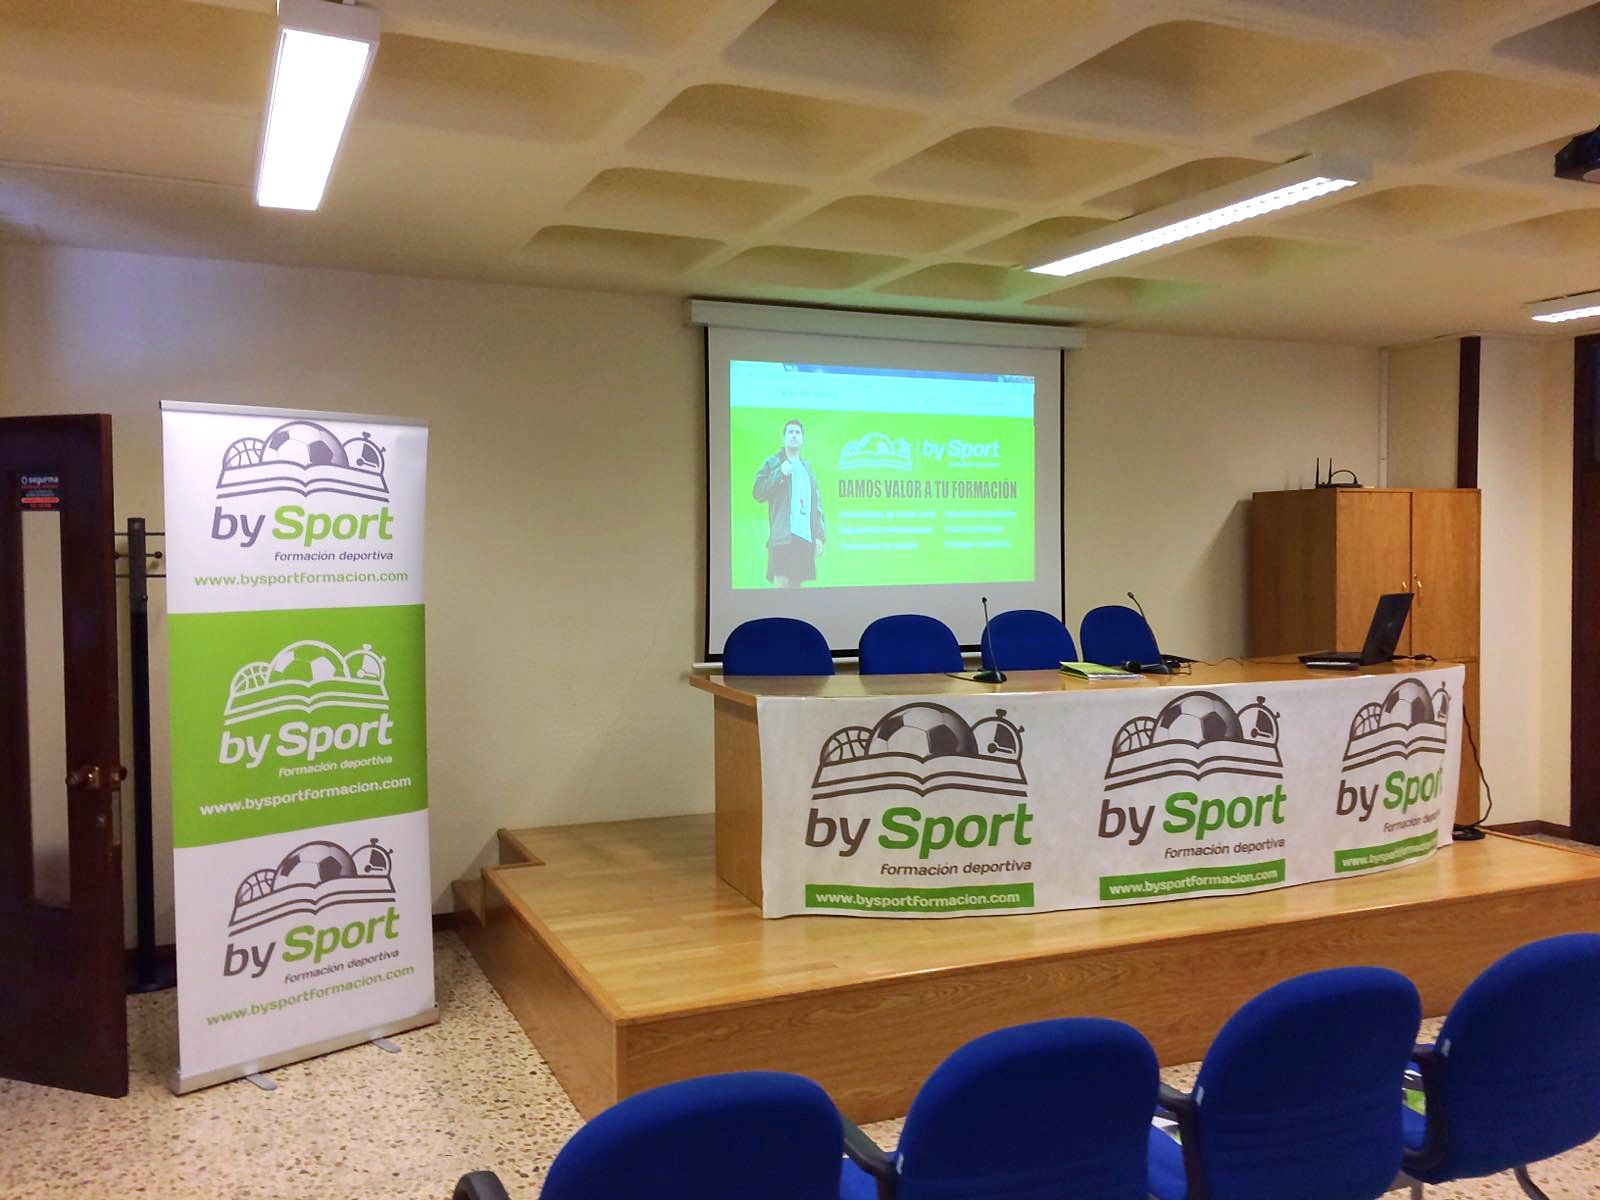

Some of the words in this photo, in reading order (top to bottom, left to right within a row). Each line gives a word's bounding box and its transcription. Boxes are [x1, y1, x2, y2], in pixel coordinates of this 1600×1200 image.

[922, 439, 945, 461] by
[946, 439, 1001, 463] Sport
[838, 479, 882, 498] DAMOS
[884, 480, 922, 498] VALOR
[924, 480, 932, 498] A
[934, 480, 949, 498] TU
[952, 478, 1018, 499] FORMACIÓN
[211, 506, 266, 547] by
[272, 505, 394, 547] Sport
[339, 551, 394, 562] deportiva
[194, 571, 409, 588] www.bysportformacion.com
[218, 731, 271, 769] by
[276, 713, 393, 761] Sport
[340, 755, 393, 769] deportiva
[199, 776, 411, 816] www.bysportformacion.com
[1335, 779, 1379, 822] by
[1383, 767, 1443, 815] Spor
[1098, 799, 1155, 846] by
[1162, 784, 1287, 841] Sport
[804, 808, 871, 857] by
[877, 803, 1034, 860] Sport
[1233, 838, 1286, 854] deportiva
[963, 860, 1032, 875] deportiva
[1108, 868, 1278, 895] www.bysportformacion.com
[816, 891, 1020, 908] www.bysportformacion.com
[223, 943, 276, 979] by
[282, 906, 400, 964] Sport
[347, 950, 400, 969] deportiva
[206, 964, 415, 1026] www.bysportformacion.com
